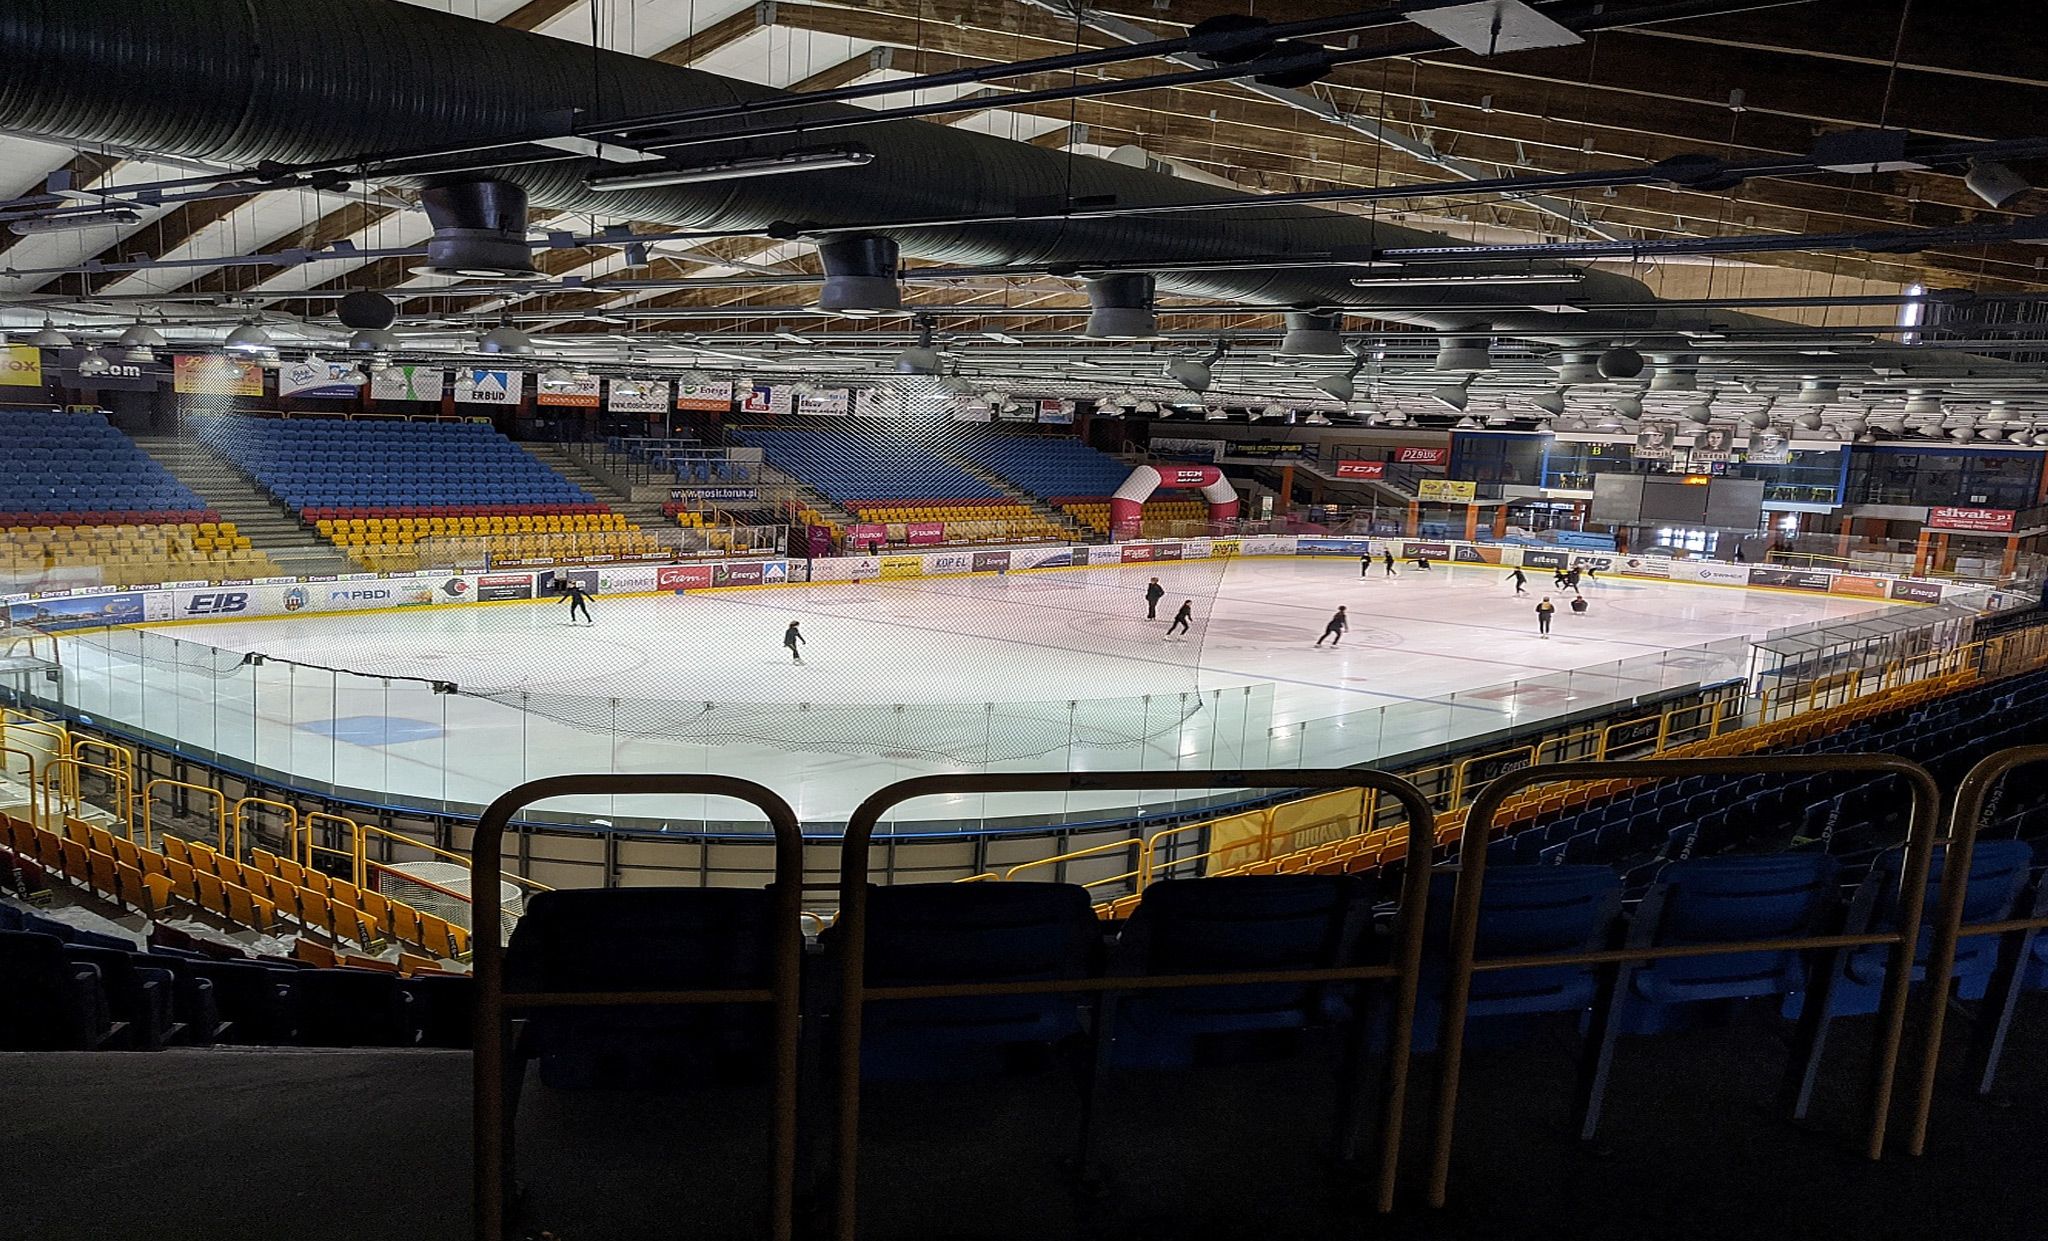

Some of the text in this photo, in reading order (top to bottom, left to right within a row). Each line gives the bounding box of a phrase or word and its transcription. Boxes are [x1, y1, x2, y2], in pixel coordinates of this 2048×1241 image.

[473, 391, 505, 401] ERBUD
[1340, 465, 1382, 473] CCM
[1936, 508, 2012, 520] silvak.pl
[731, 571, 760, 579] Energa
[352, 589, 391, 600] PBDI
[1911, 589, 1938, 598] Energa
[186, 593, 248, 612] EIB
